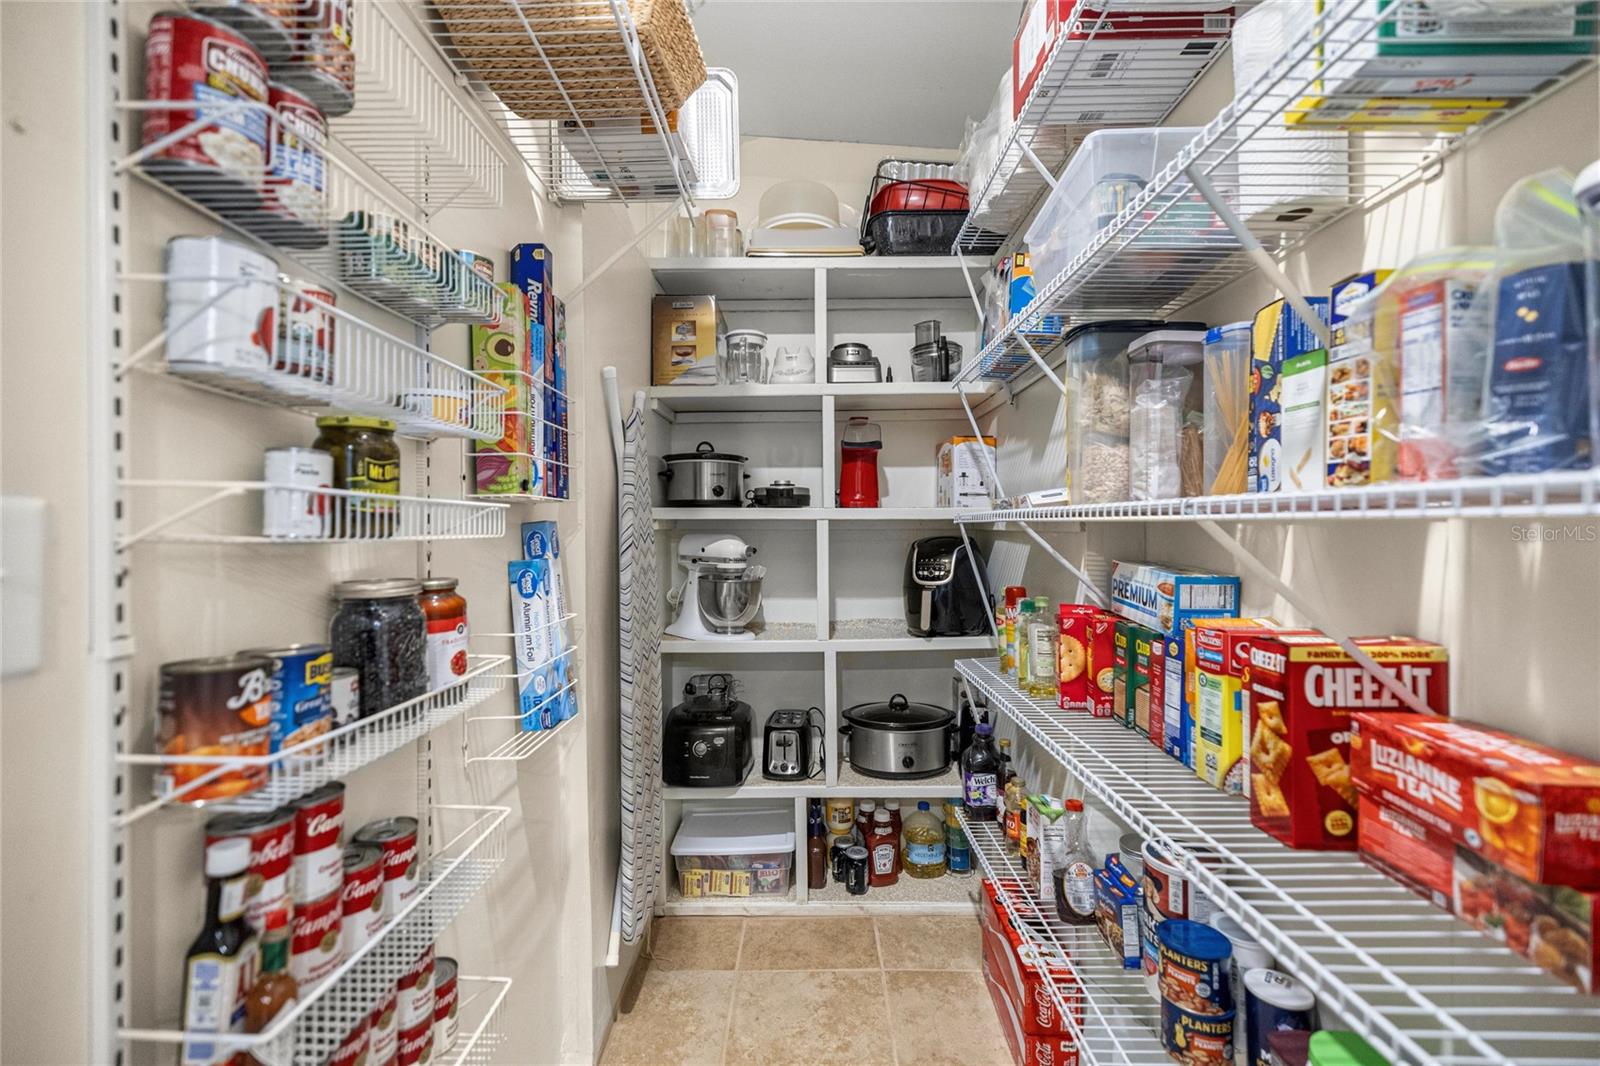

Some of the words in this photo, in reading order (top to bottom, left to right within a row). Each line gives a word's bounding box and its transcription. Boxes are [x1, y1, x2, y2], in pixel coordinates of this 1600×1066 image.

[1112, 579, 1158, 610] PREMIUM
[523, 601, 533, 646] Aluminm
[526, 647, 535, 662] Foil
[1370, 738, 1464, 812] LUZIANNE
[1394, 769, 1434, 806] TEA
[1161, 943, 1209, 972] PLANTERS
[1181, 1015, 1232, 1033] PLANTERS
